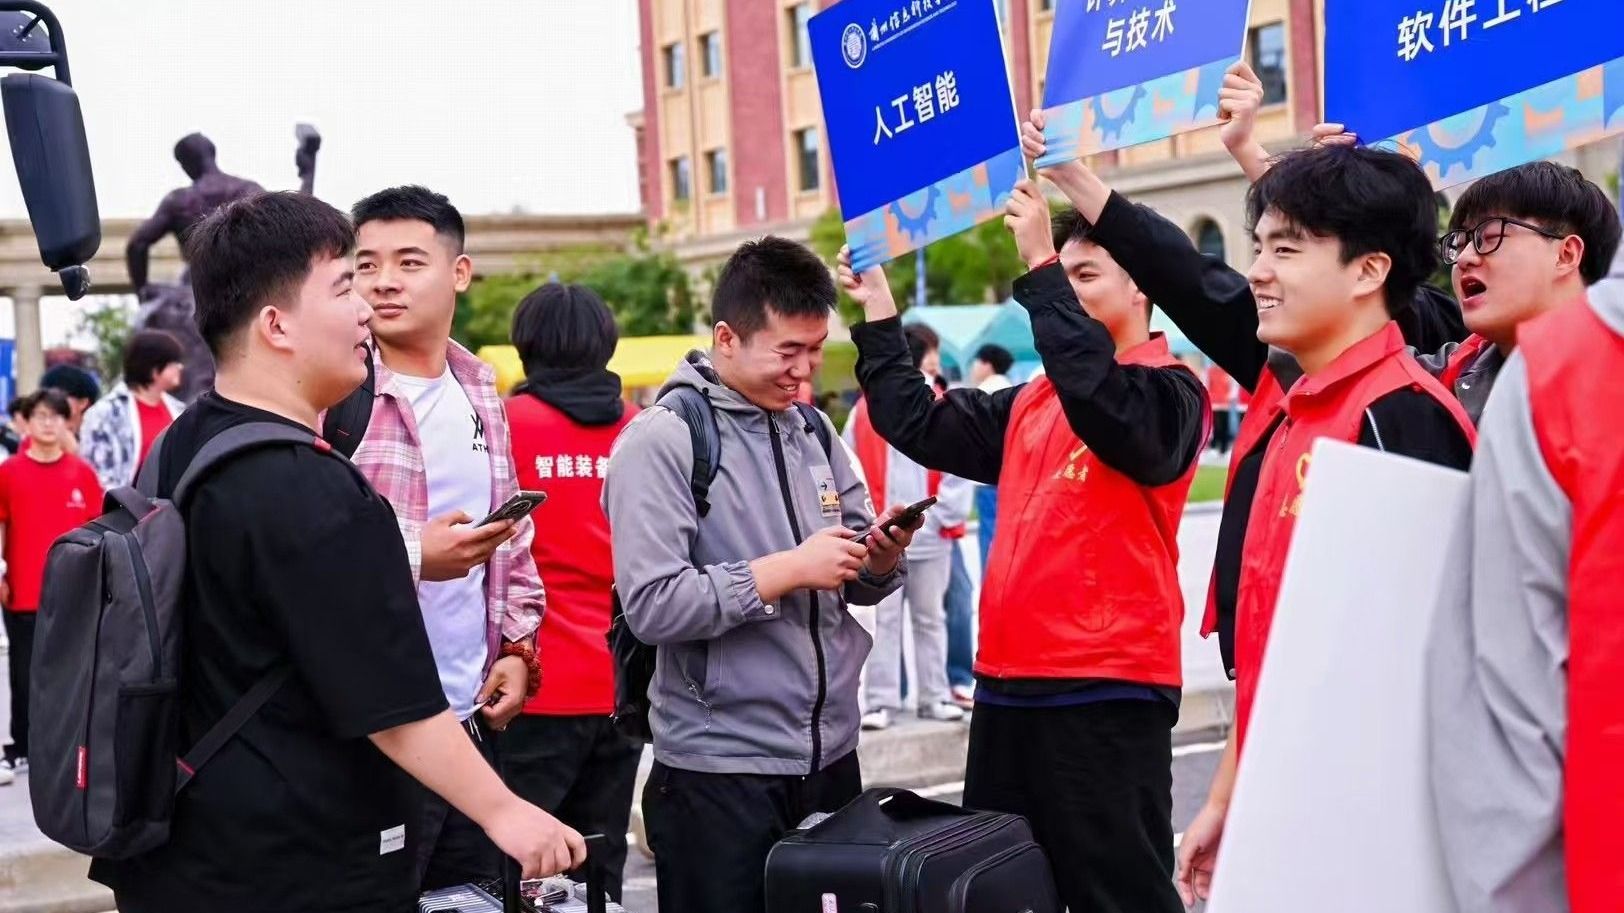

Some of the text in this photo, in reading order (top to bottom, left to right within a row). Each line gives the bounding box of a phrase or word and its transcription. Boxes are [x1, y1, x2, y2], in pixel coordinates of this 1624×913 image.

[1102, 0, 1177, 57] 与技术
[1397, 0, 1564, 62] 软件工
[873, 70, 960, 146] 人工智能
